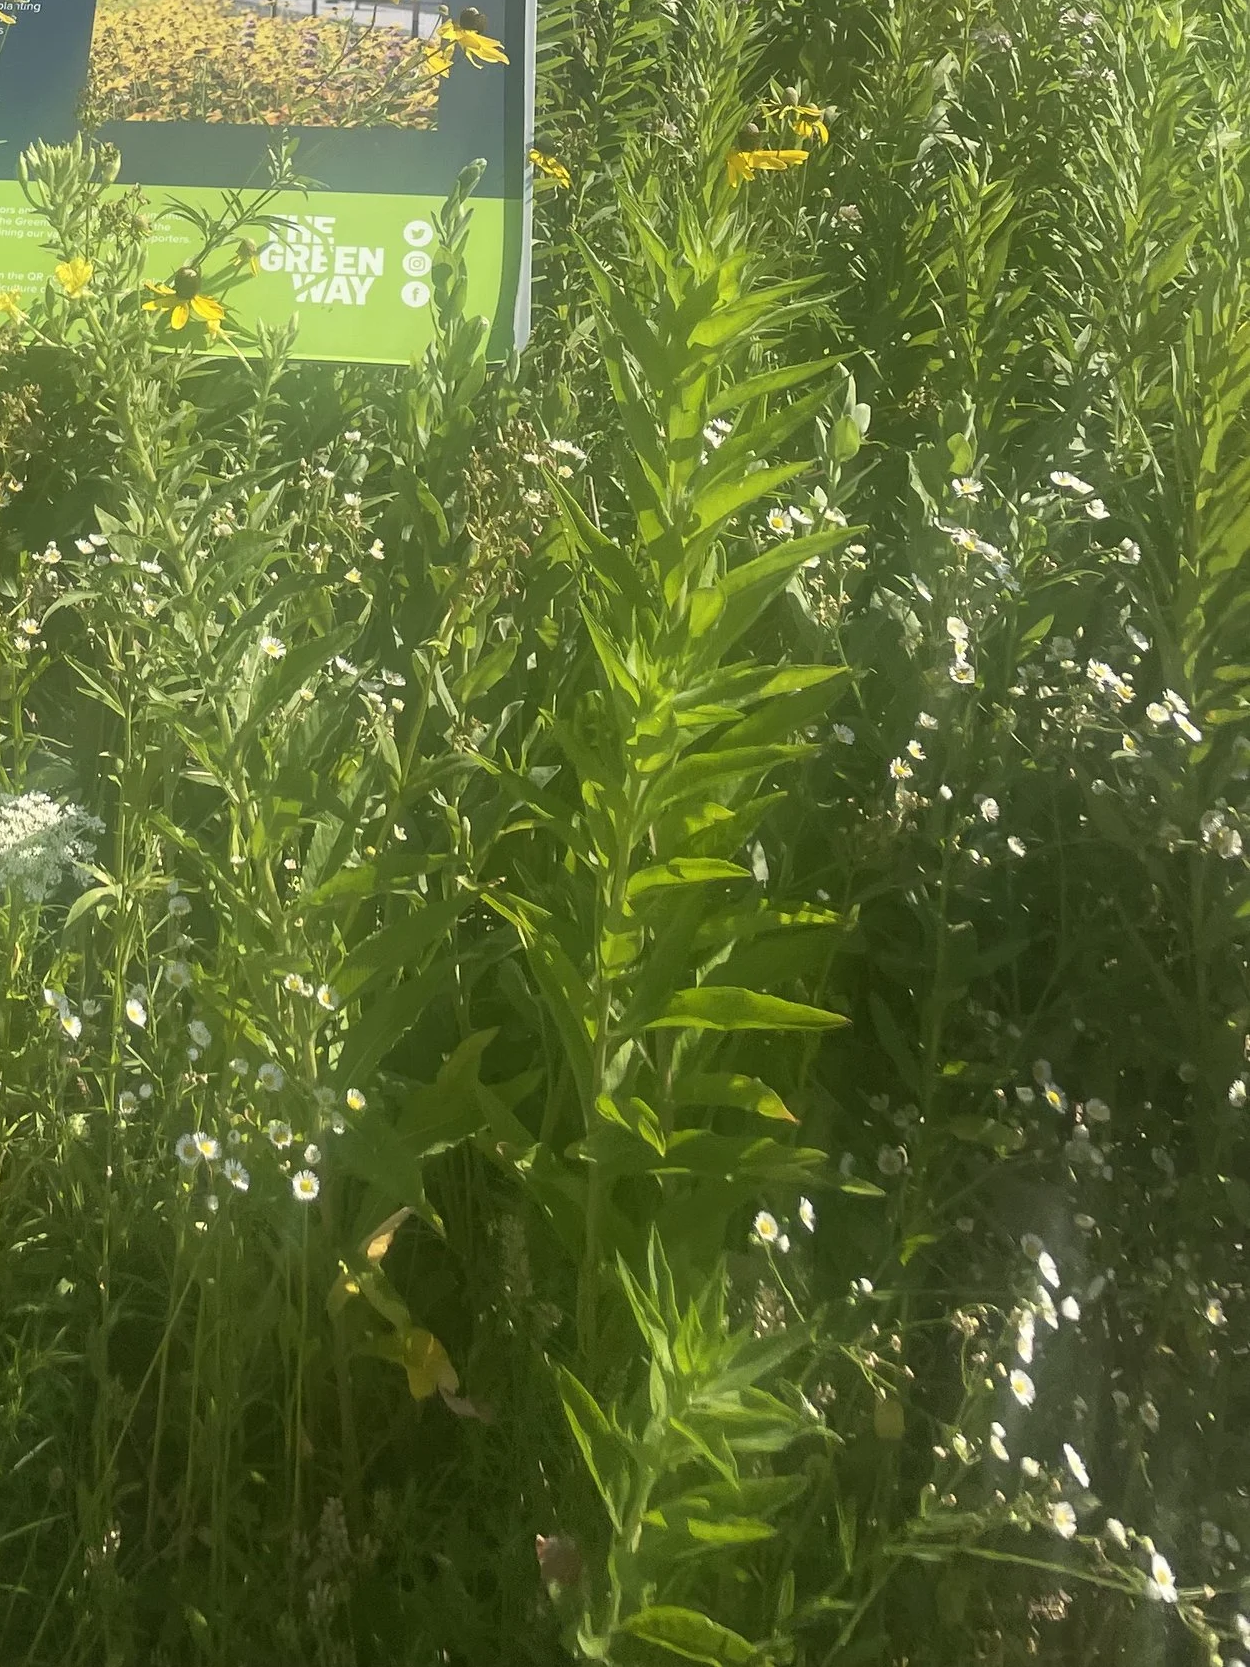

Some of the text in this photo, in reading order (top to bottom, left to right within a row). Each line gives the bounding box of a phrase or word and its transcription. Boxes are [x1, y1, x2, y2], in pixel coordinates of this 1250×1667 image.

[268, 214, 336, 244] THE
[259, 243, 384, 276] GREEN
[7, 272, 24, 280] the
[27, 272, 43, 281] QR
[292, 274, 375, 305] WAY
